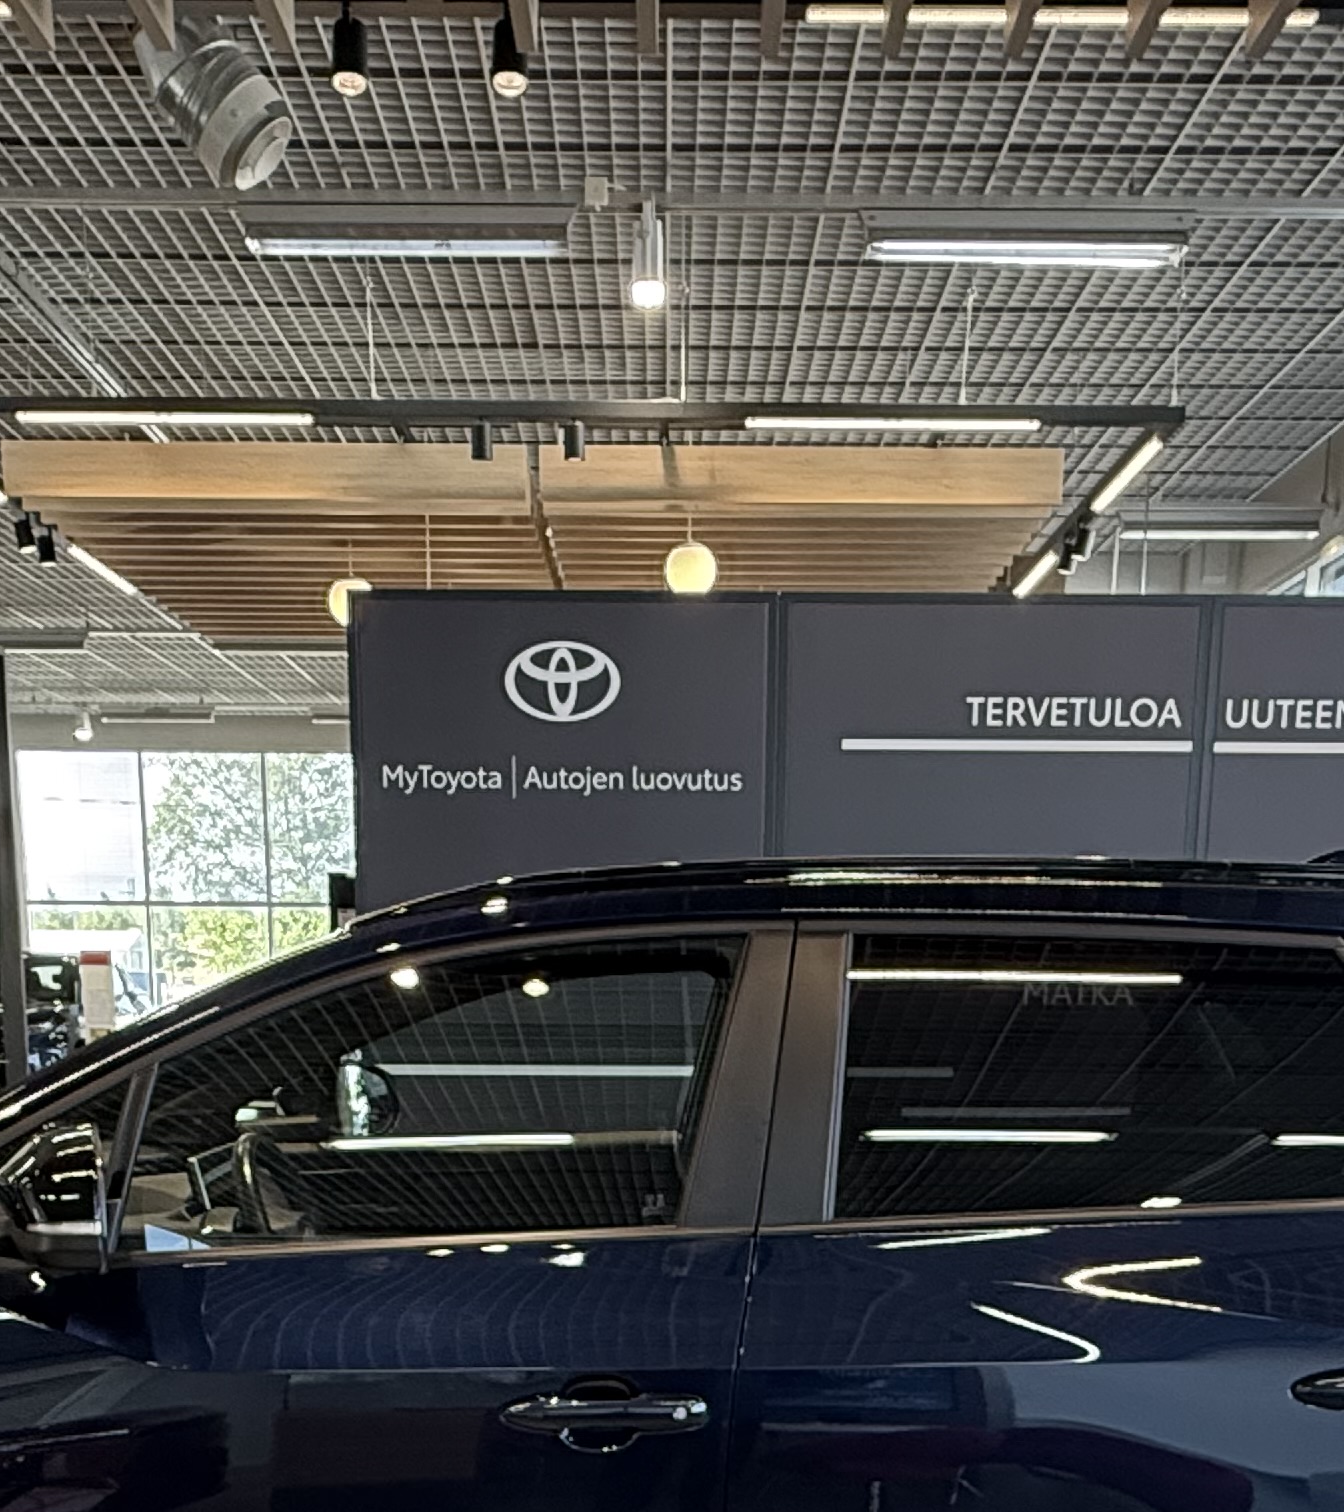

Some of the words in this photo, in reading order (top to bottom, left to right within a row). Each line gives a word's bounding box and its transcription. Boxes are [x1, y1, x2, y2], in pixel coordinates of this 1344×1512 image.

[966, 696, 1181, 728] TERVETULOA
[382, 763, 501, 796] MyToyota
[523, 764, 623, 797] Autojen
[632, 764, 742, 793] luovutus
